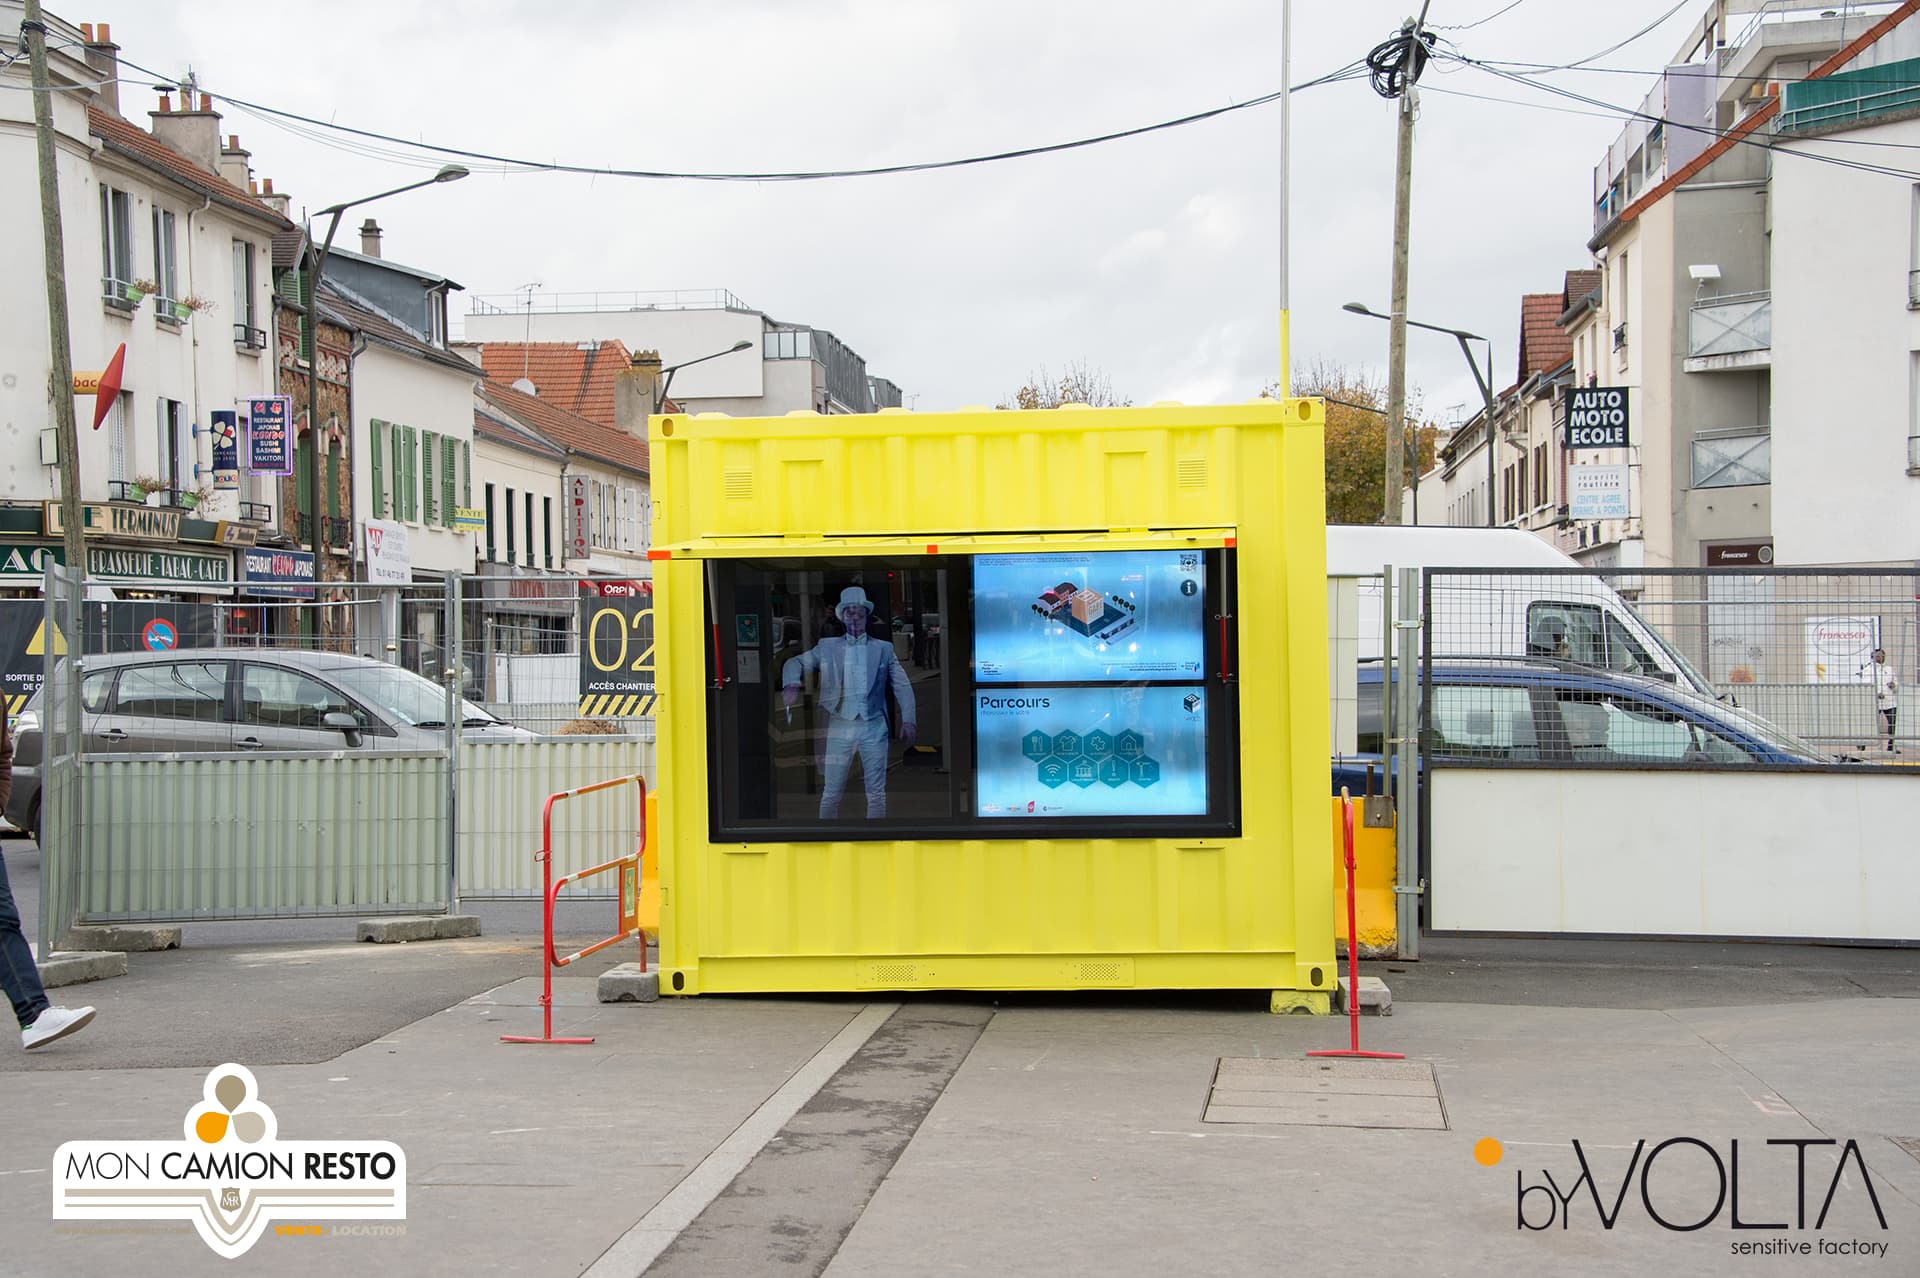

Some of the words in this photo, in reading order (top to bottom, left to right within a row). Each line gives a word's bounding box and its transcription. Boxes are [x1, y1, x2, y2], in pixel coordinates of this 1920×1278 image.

[1573, 391, 1622, 409] AUTO
[1570, 409, 1625, 427] MOTO
[1571, 427, 1624, 445] ECOLE
[110, 507, 178, 538] TERMINUS
[574, 478, 585, 558] AUDITION
[589, 607, 656, 672] 02
[5, 673, 35, 682] SORTIE
[588, 680, 615, 690] ACCÈS
[616, 682, 656, 691] CHANTIER
[23, 683, 34, 691] DE
[980, 696, 1050, 709] Parcours
